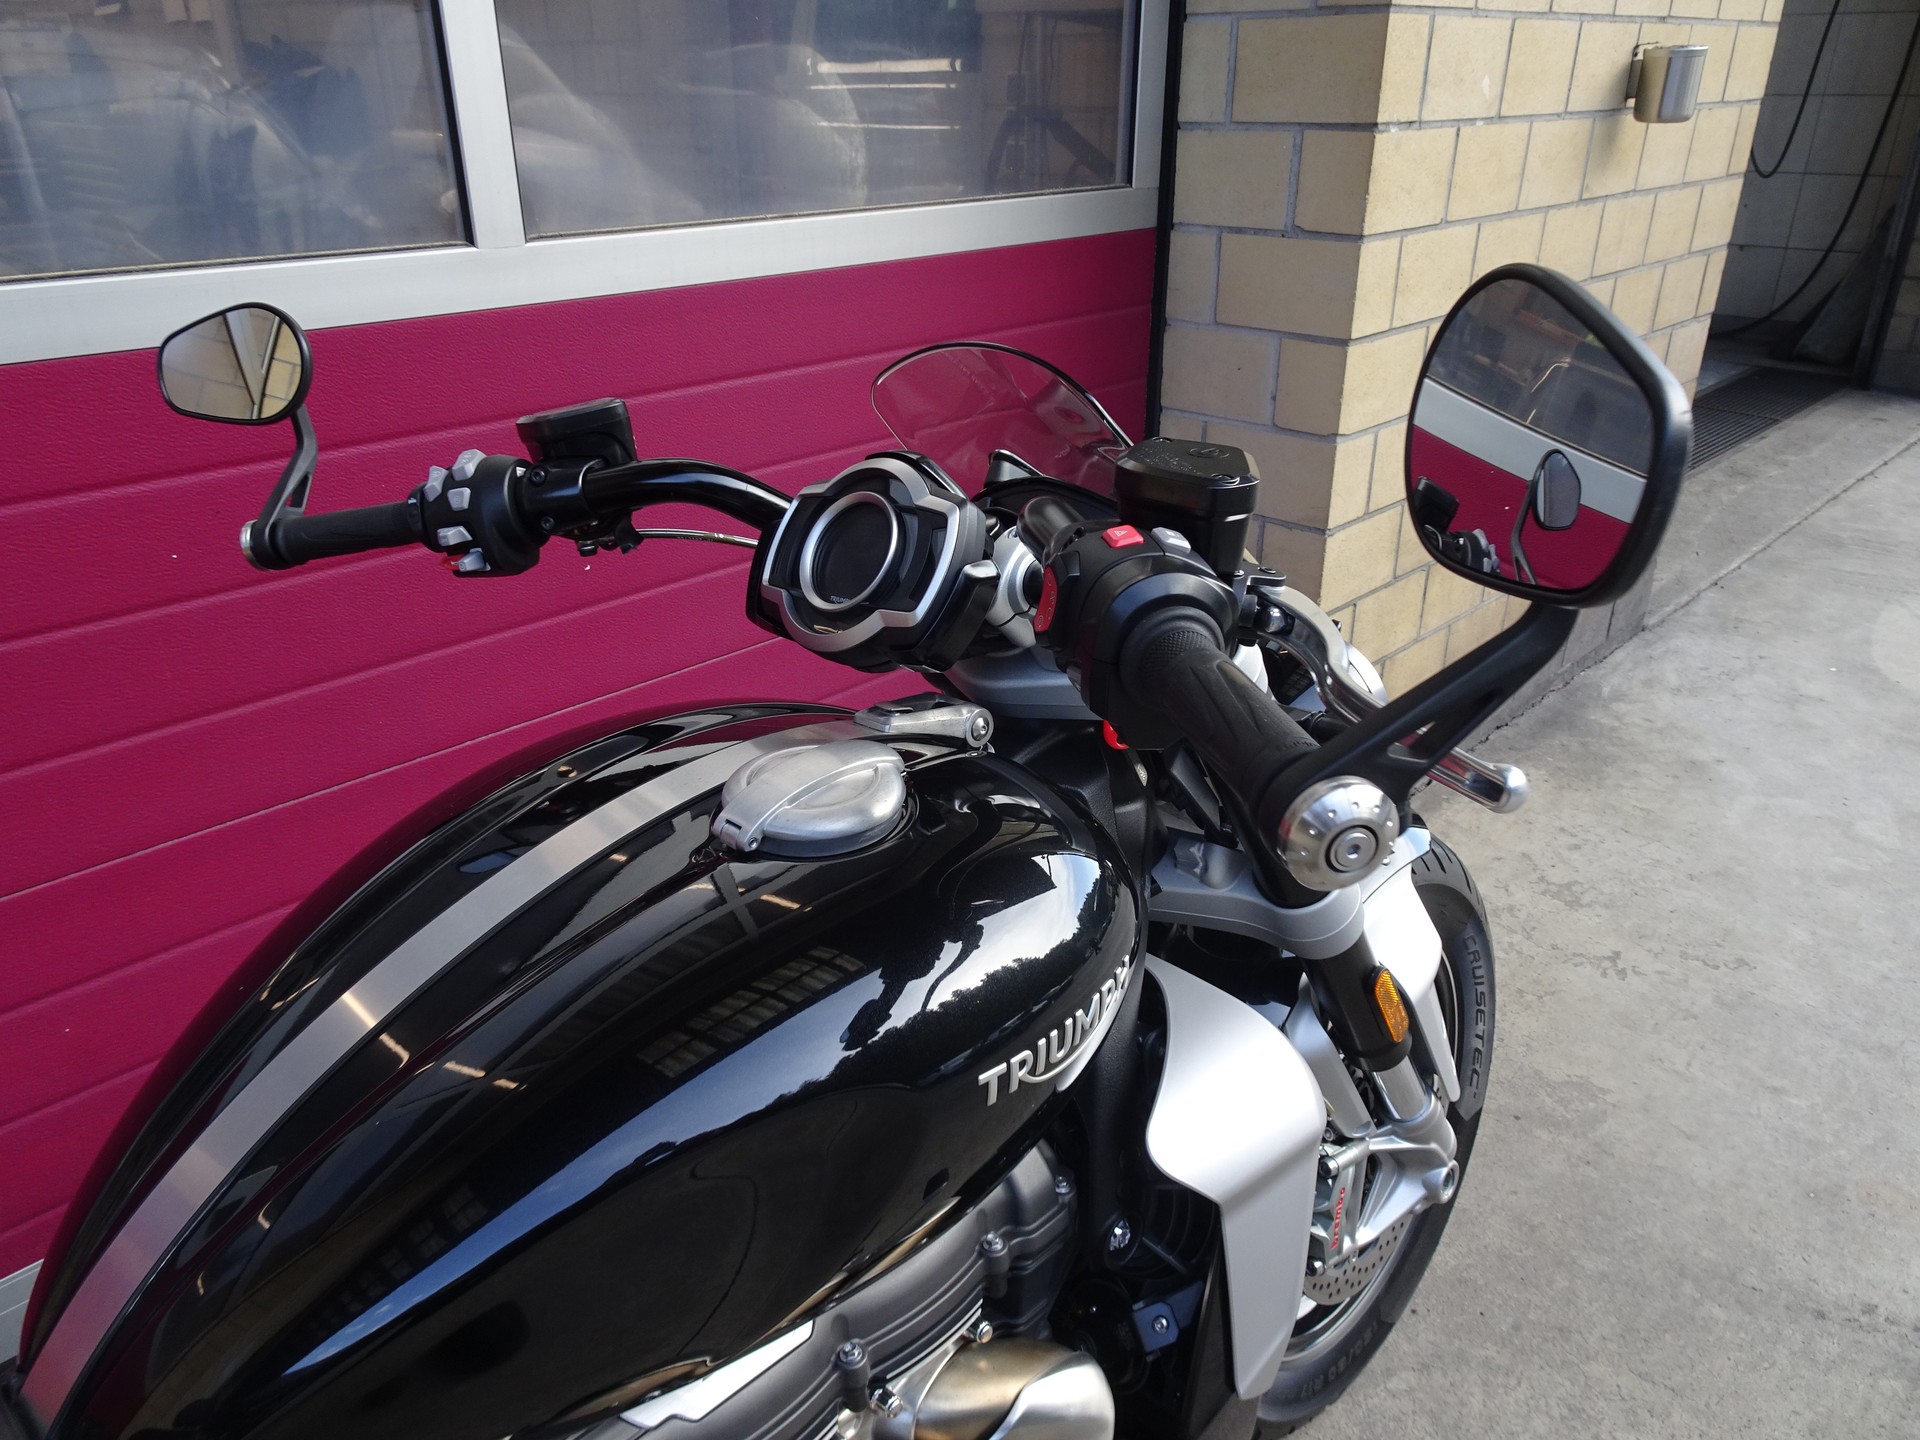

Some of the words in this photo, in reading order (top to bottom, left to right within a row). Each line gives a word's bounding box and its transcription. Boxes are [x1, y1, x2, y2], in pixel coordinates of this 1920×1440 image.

[978, 955, 1130, 1106] TRIUMPH
[1463, 934, 1486, 1089] CRUISETEC
[1330, 1187, 1345, 1248] brembo
